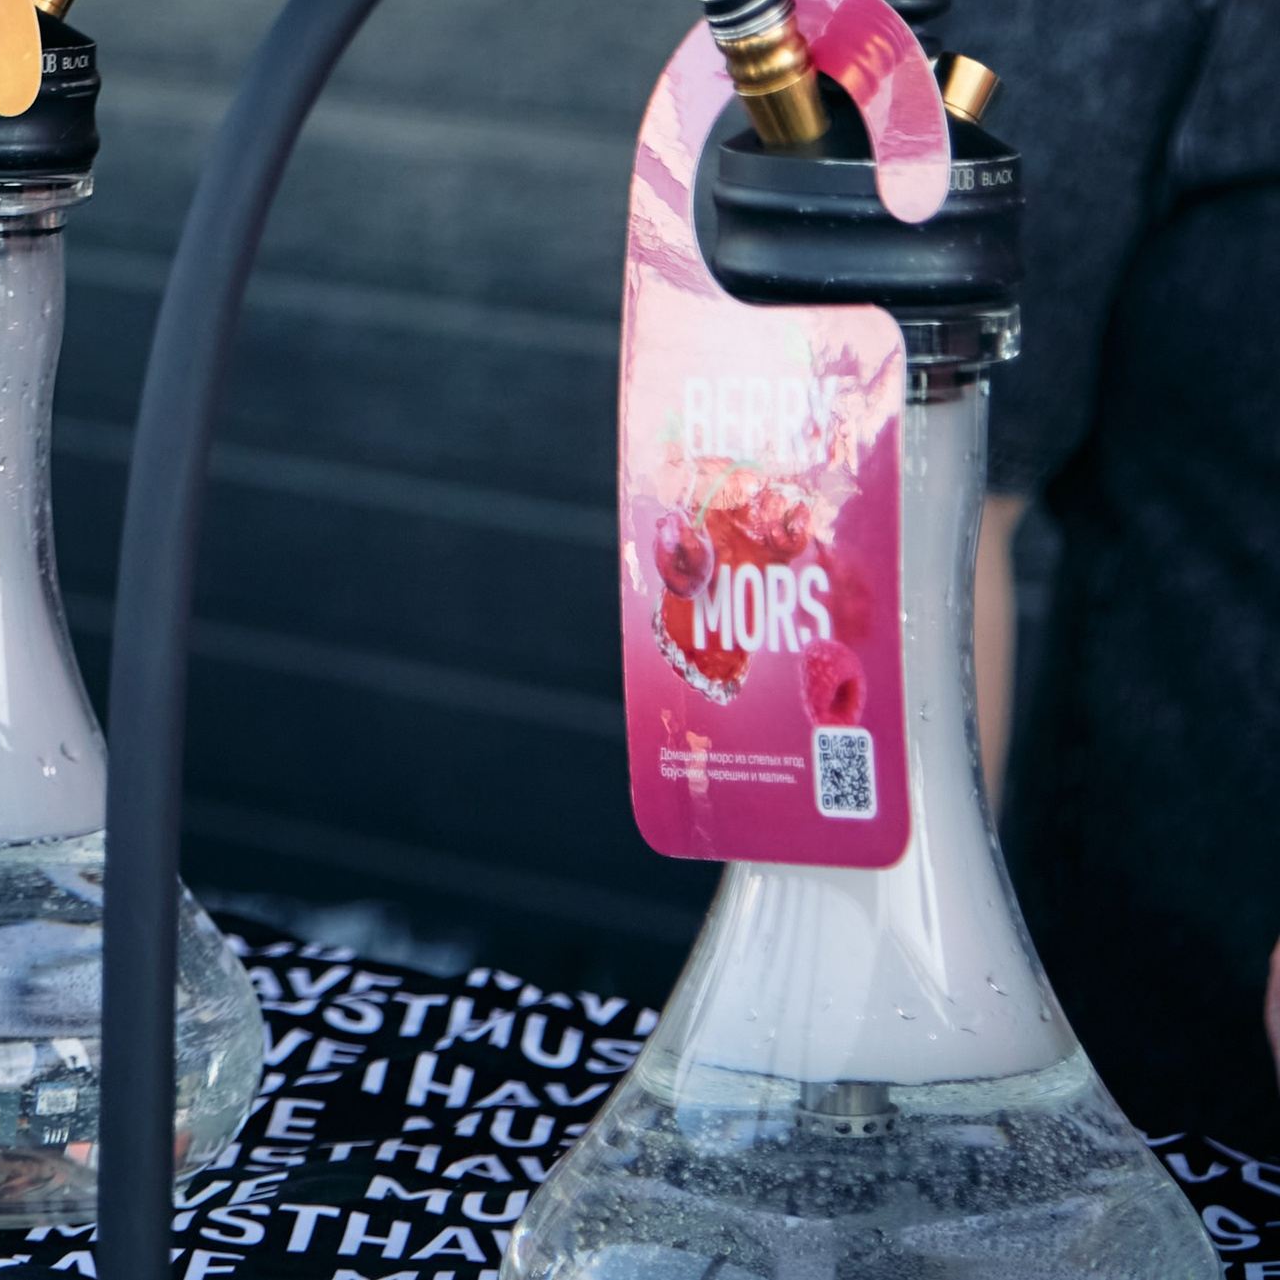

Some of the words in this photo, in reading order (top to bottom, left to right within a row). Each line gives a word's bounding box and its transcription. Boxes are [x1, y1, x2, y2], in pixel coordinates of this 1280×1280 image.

[62, 55, 89, 70] BLACK
[982, 169, 1013, 187] BLACK
[692, 562, 832, 653] MORS
[709, 752, 733, 766] морс
[783, 757, 805, 769] ягод
